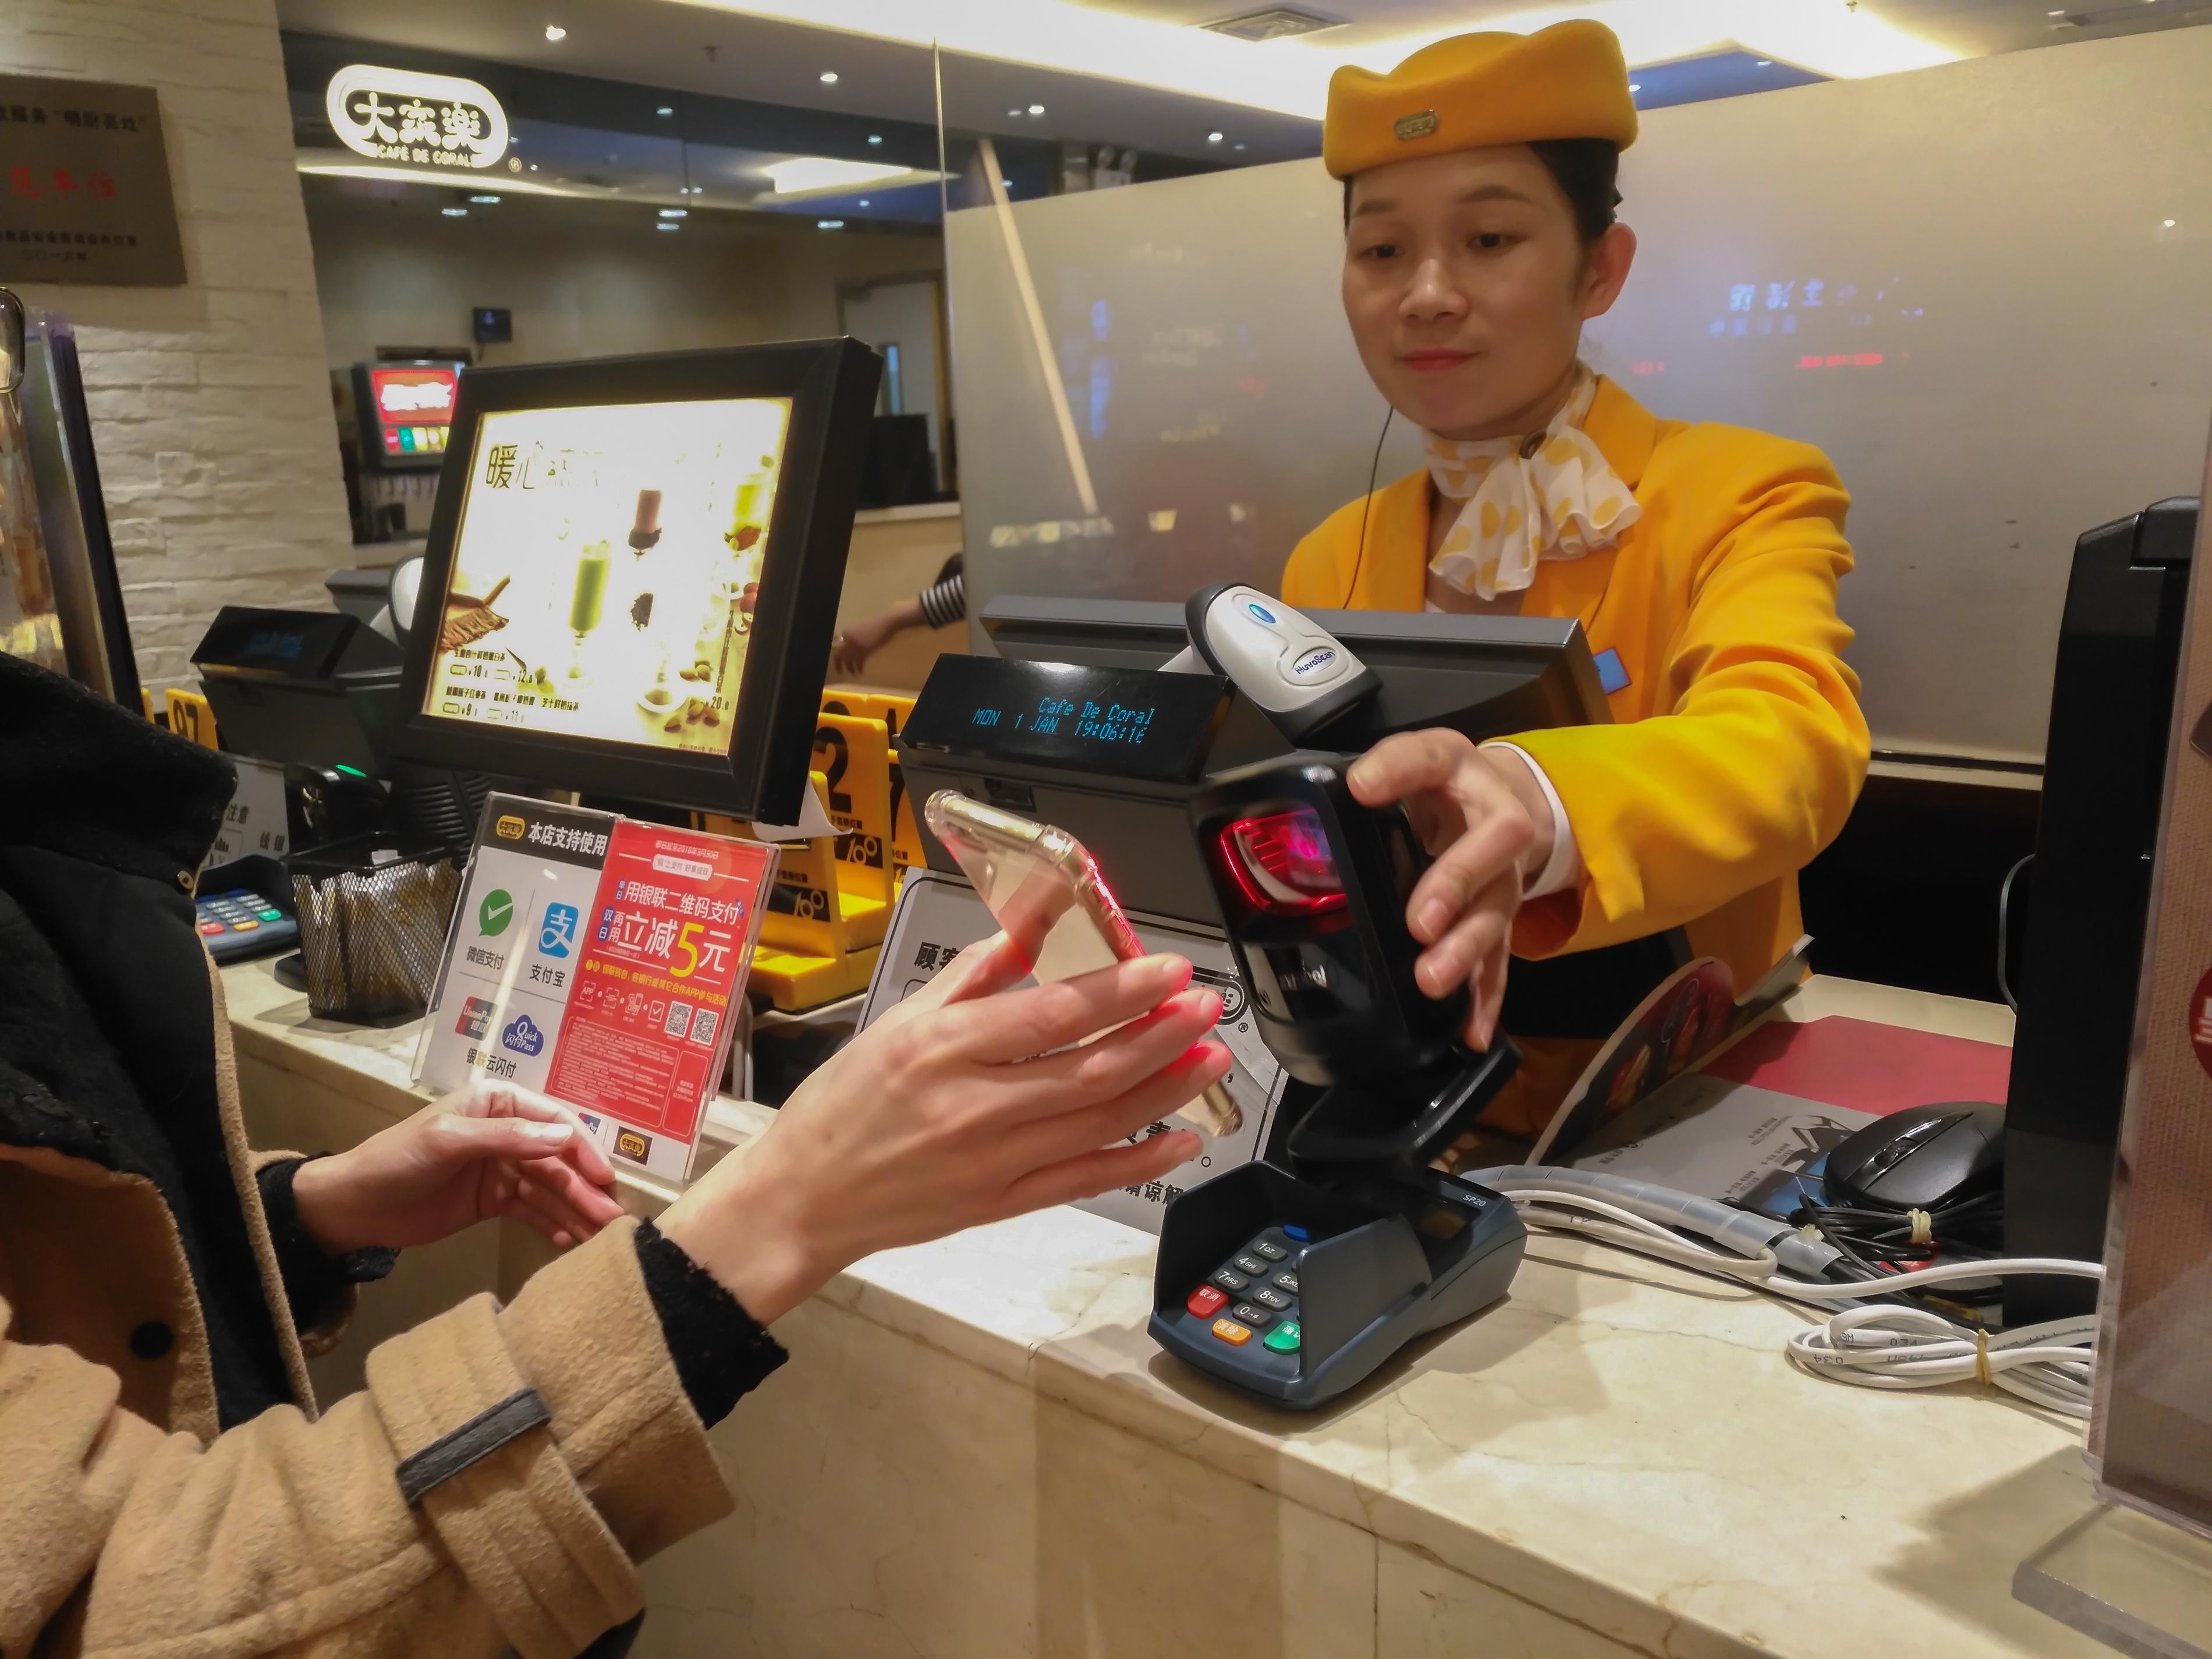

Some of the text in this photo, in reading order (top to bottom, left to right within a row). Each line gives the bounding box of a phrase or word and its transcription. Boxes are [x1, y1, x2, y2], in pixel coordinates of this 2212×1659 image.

[412, 148, 430, 164] DE
[433, 151, 473, 168] CORAL
[971, 708, 1002, 726] MON
[1015, 713, 1025, 729] 1
[1030, 715, 1061, 733] JAN
[1038, 697, 1155, 725] Cafe De Coral
[527, 821, 609, 856] 本店支持使用
[624, 881, 739, 926] 用银联二维码支付
[466, 945, 505, 970] 微信支付
[529, 963, 566, 988] 支付宝
[582, 986, 594, 996] APP
[463, 1005, 493, 1026] UnionPay
[516, 1021, 539, 1043] Quick
[466, 1047, 517, 1079] 银联云闪付
[1462, 1194, 1487, 1207] SP20
[1199, 1288, 1221, 1302] 取消
[1216, 1320, 1239, 1336] 清除
